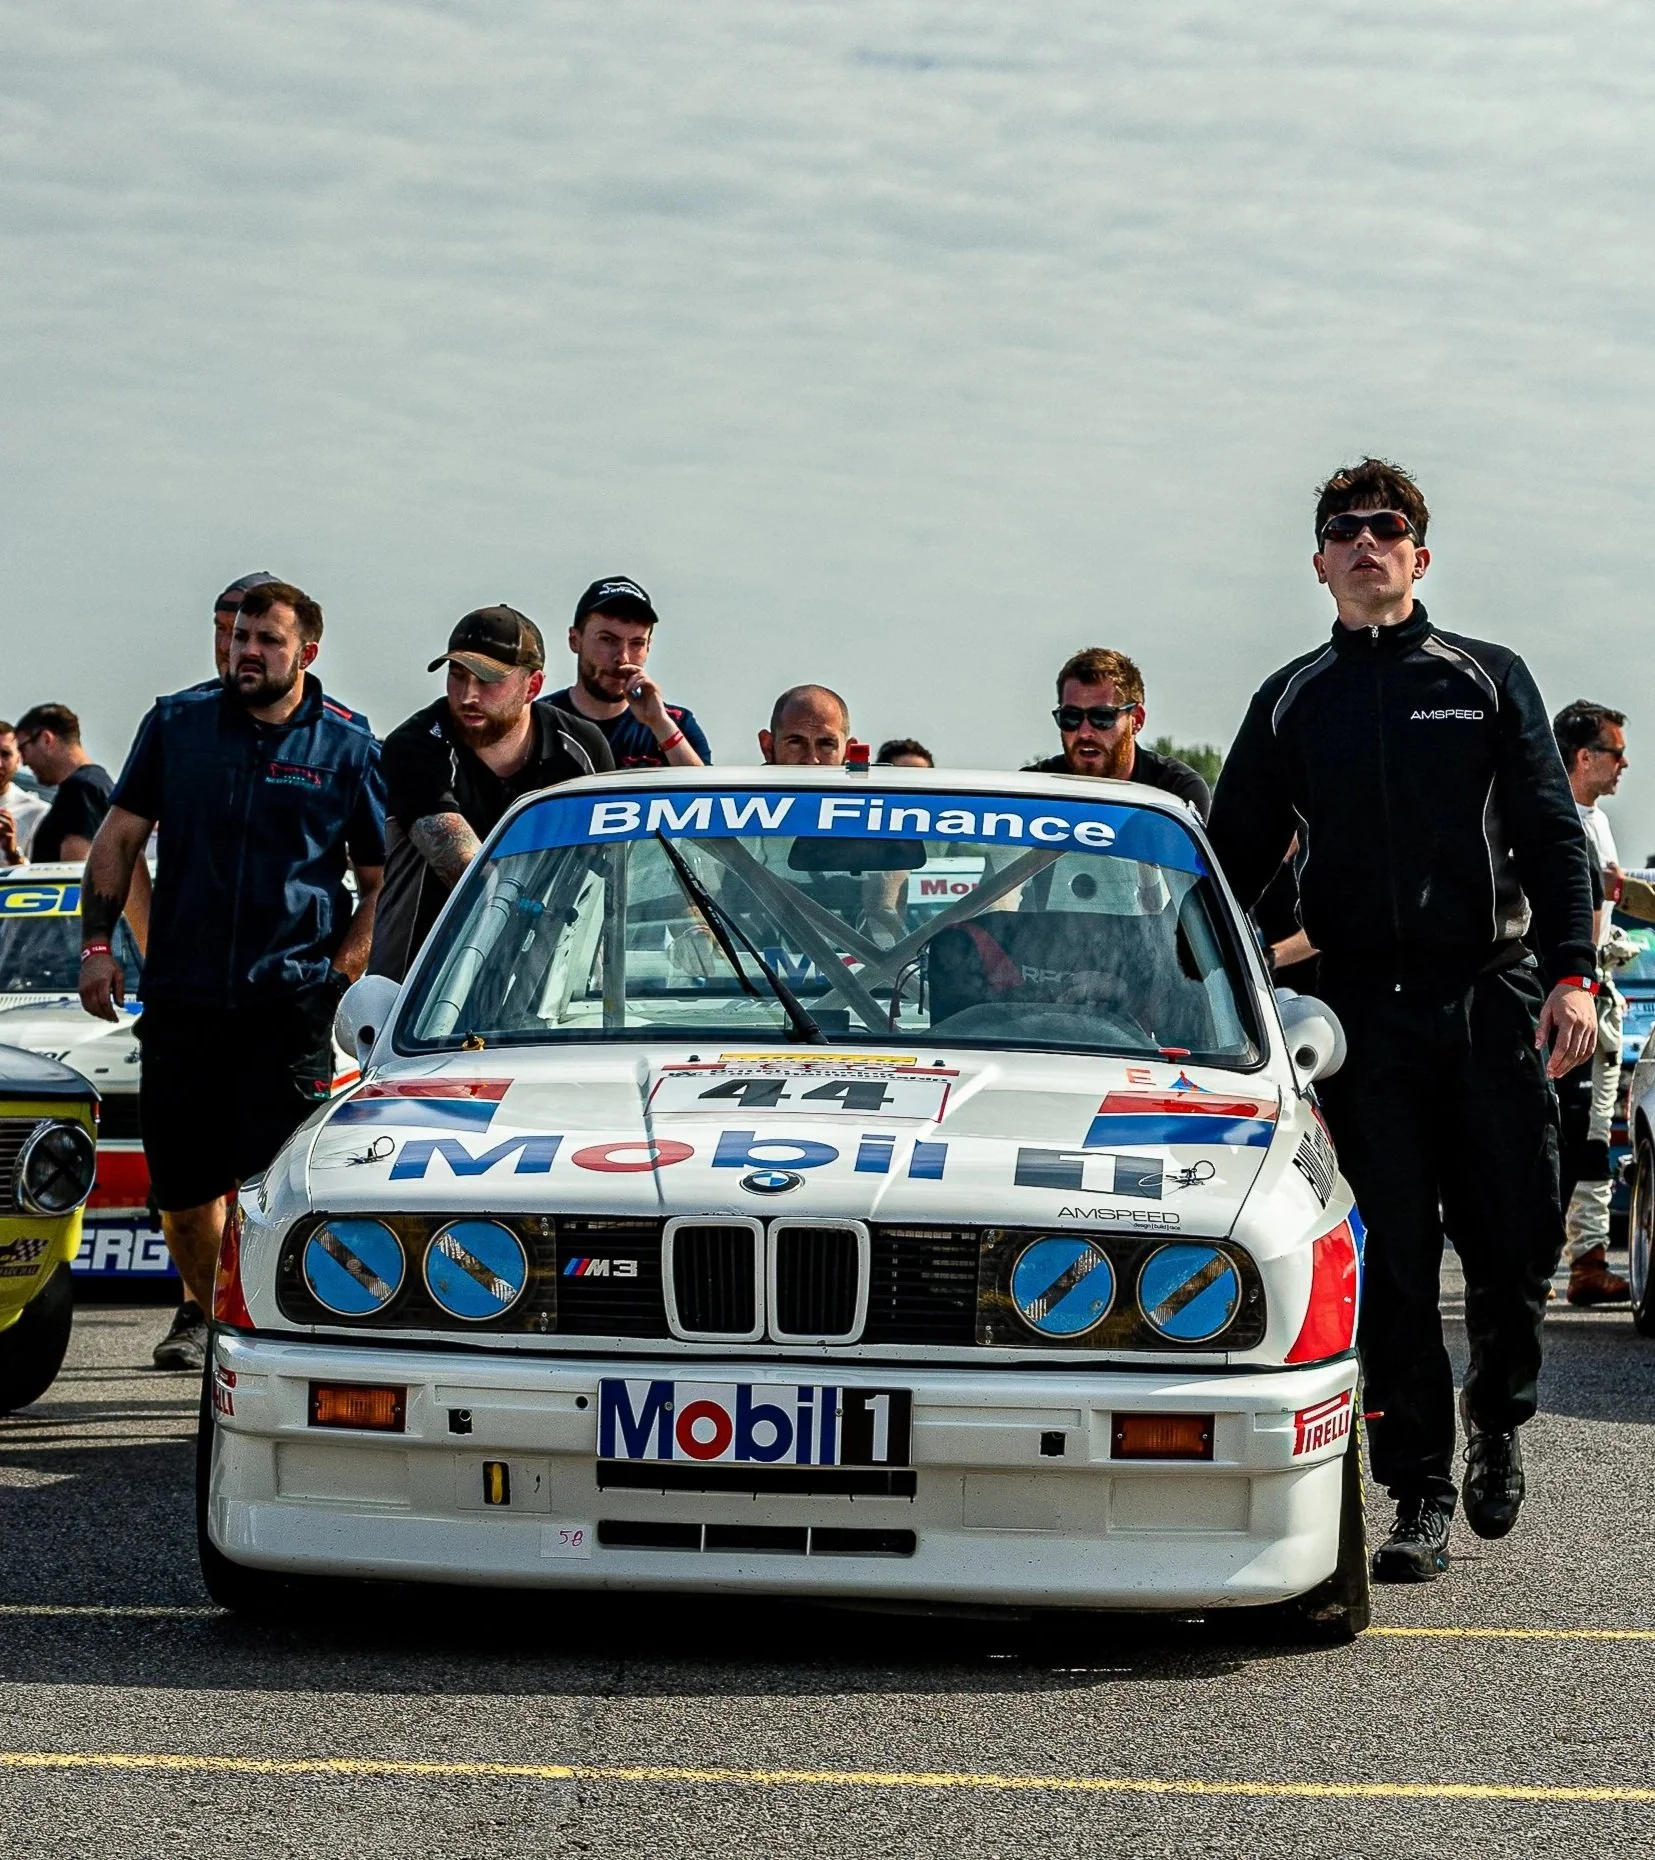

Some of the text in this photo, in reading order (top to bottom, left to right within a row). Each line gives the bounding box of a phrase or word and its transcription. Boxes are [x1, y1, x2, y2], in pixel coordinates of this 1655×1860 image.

[1410, 709, 1484, 720] AMSPEED
[588, 797, 1116, 847] BMW Finance
[698, 1079, 894, 1111] 44
[389, 1130, 949, 1181] Mobil
[1058, 1207, 1180, 1224] AMSPEED
[584, 1259, 638, 1277] M3
[599, 1380, 890, 1466] Mobil 1
[1293, 1390, 1350, 1456] PIRELLI
